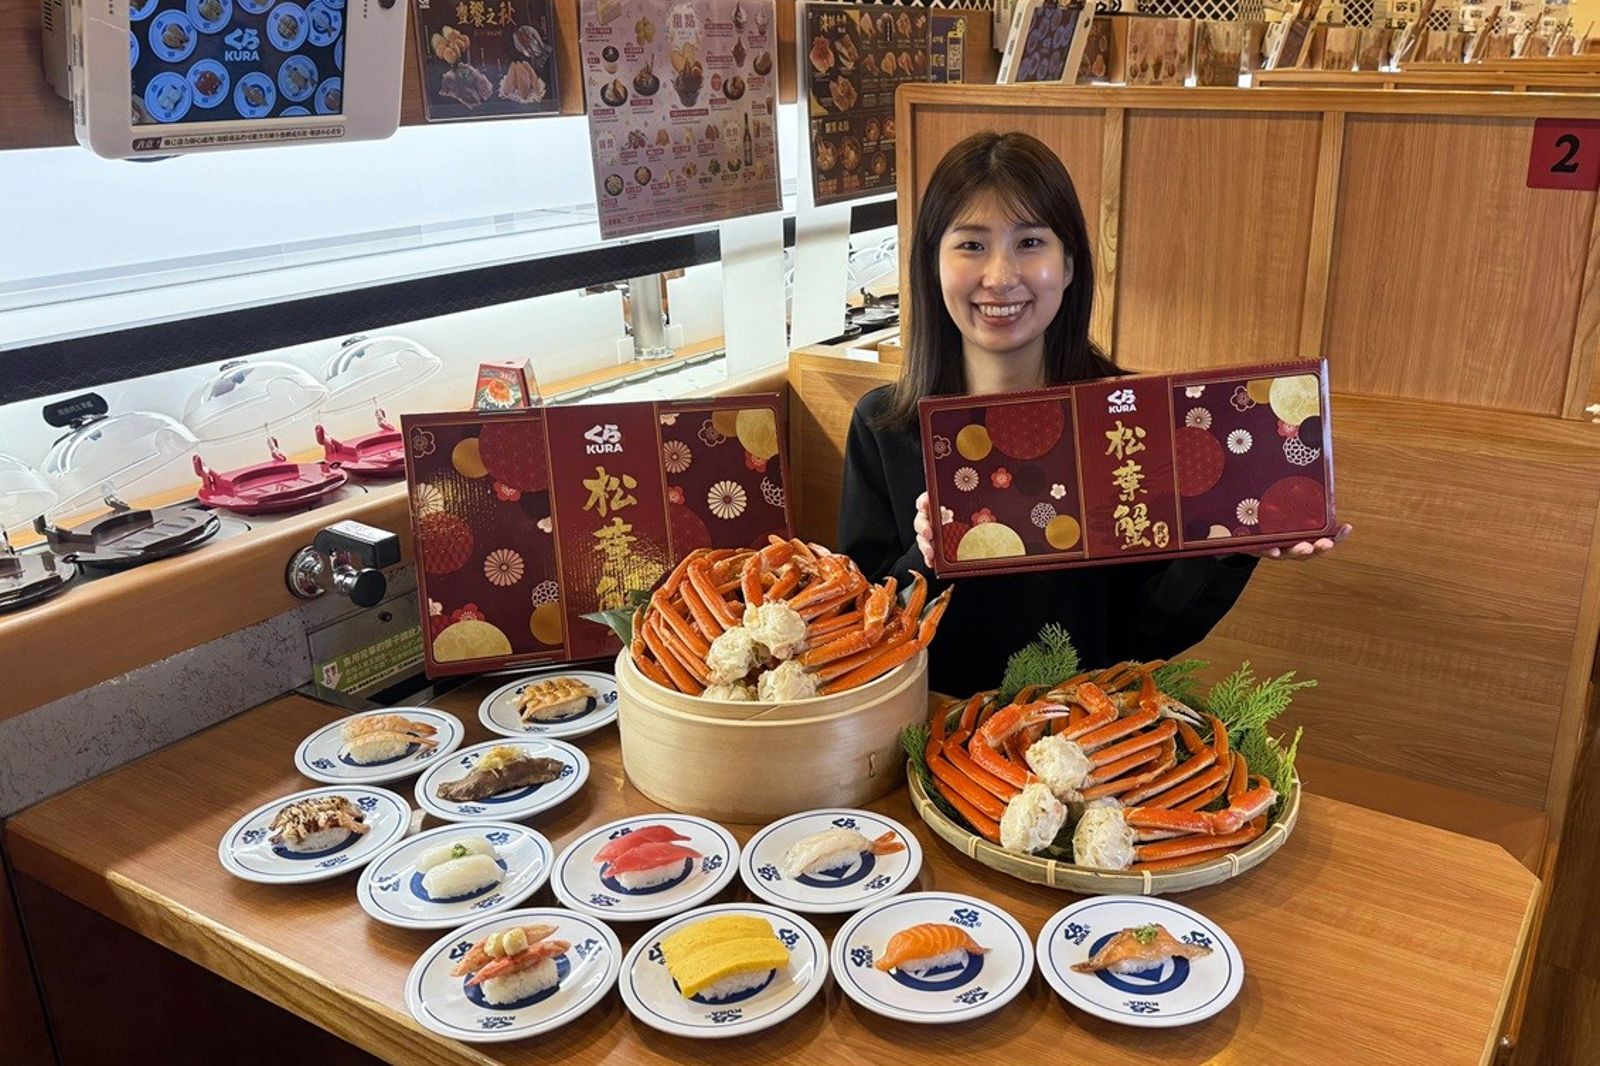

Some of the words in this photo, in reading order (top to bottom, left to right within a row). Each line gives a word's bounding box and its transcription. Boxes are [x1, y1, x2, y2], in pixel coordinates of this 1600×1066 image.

[224, 28, 260, 50] くら
[225, 51, 260, 62] KURA
[1550, 133, 1580, 173] 2
[1107, 389, 1136, 405] くら
[1108, 404, 1137, 414] KURA
[584, 424, 622, 444] くら
[586, 443, 623, 455] KURA
[1105, 420, 1151, 550] 松葉蟹
[949, 916, 975, 929] KURA
